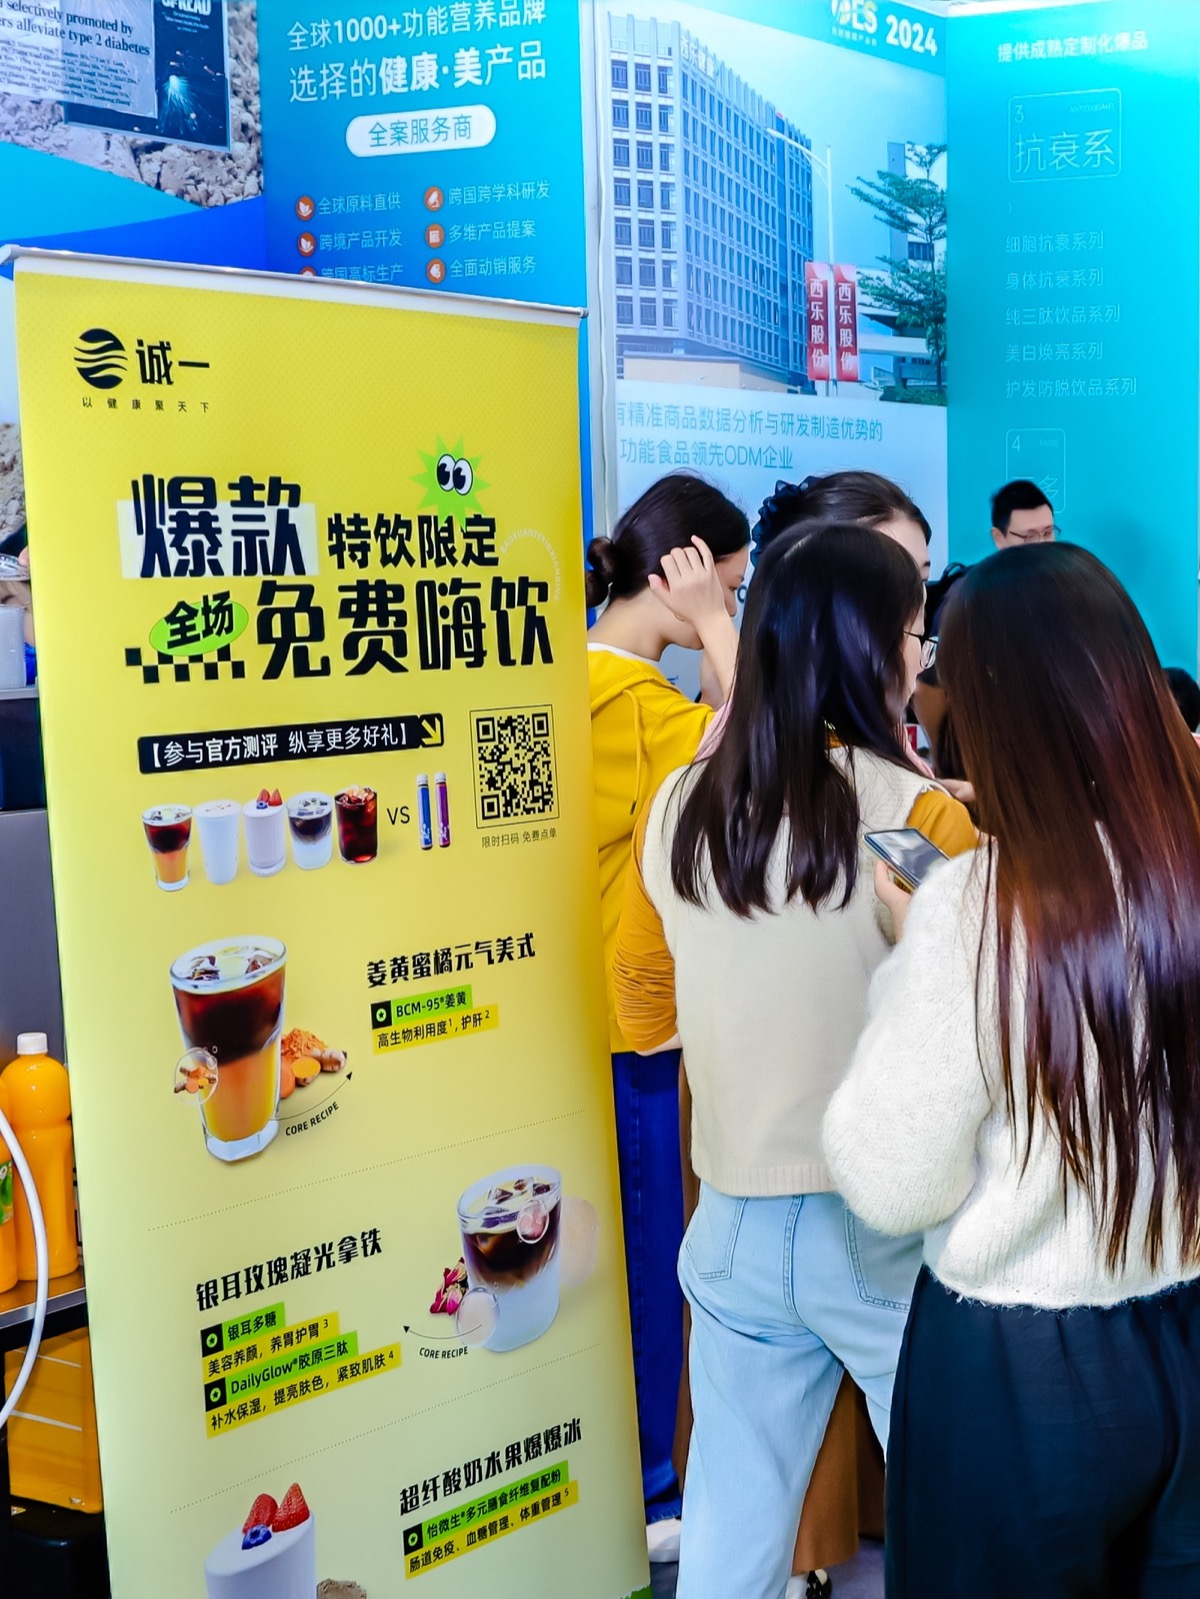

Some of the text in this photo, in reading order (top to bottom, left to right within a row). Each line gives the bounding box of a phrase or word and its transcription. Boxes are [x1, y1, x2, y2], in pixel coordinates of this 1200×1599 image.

[7, 0, 133, 37] selectively promoted by
[287, 0, 547, 51] 全球1000+功能营养品牌
[17, 18, 66, 39] alleviate
[68, 29, 92, 46] type
[95, 34, 102, 46] 2
[105, 37, 150, 56] diabetes
[885, 14, 938, 57] 2024
[998, 31, 1148, 62] 提供成熟定制化爆品
[289, 40, 546, 103] 选择的健康·美产品
[368, 114, 472, 147] 全案服务商
[1014, 105, 1024, 123] 3
[1014, 129, 1115, 174] 抗衰系
[318, 191, 401, 215] 全球原料直供
[448, 179, 550, 206] 跨国跨学科研发
[319, 228, 402, 251] 跨境产品开发
[448, 219, 536, 243] 多维产品提案
[1005, 230, 1104, 253] 细胞抗衰系列
[450, 255, 537, 279] 全面动销服务
[1005, 267, 1104, 290] 身体抗衰系列
[809, 278, 825, 368] 西乐股份
[838, 282, 854, 373] 西乐股份
[1005, 304, 1121, 326] 纯三肽饮品系列
[135, 339, 210, 385] 诚一
[1005, 341, 1104, 363] 美白焕亮系列
[1005, 377, 1138, 399] 护发防脱饮品系列
[82, 397, 209, 413] 以健康聚天下
[1011, 434, 1021, 452] 4
[131, 474, 306, 578] 爆款
[328, 512, 499, 570] 特饮限定
[163, 591, 235, 649] 全场
[257, 576, 554, 680] 免费嗨饮
[151, 722, 408, 769] 【参与官方测评 纵享更多好礼】
[387, 807, 410, 825] VS
[481, 828, 557, 848] 限时扫码 免费点单
[367, 932, 536, 988] 姜黄蜜橘元气美式
[285, 1101, 339, 1137] CORE RECIPE
[196, 1227, 383, 1312] 银耳玫瑰凝光拿铁
[226, 1310, 277, 1342] 银耳多糖
[419, 1346, 469, 1360] CORE RECIPE
[399, 1417, 582, 1516] 超纤酸奶水果爆爆冰
